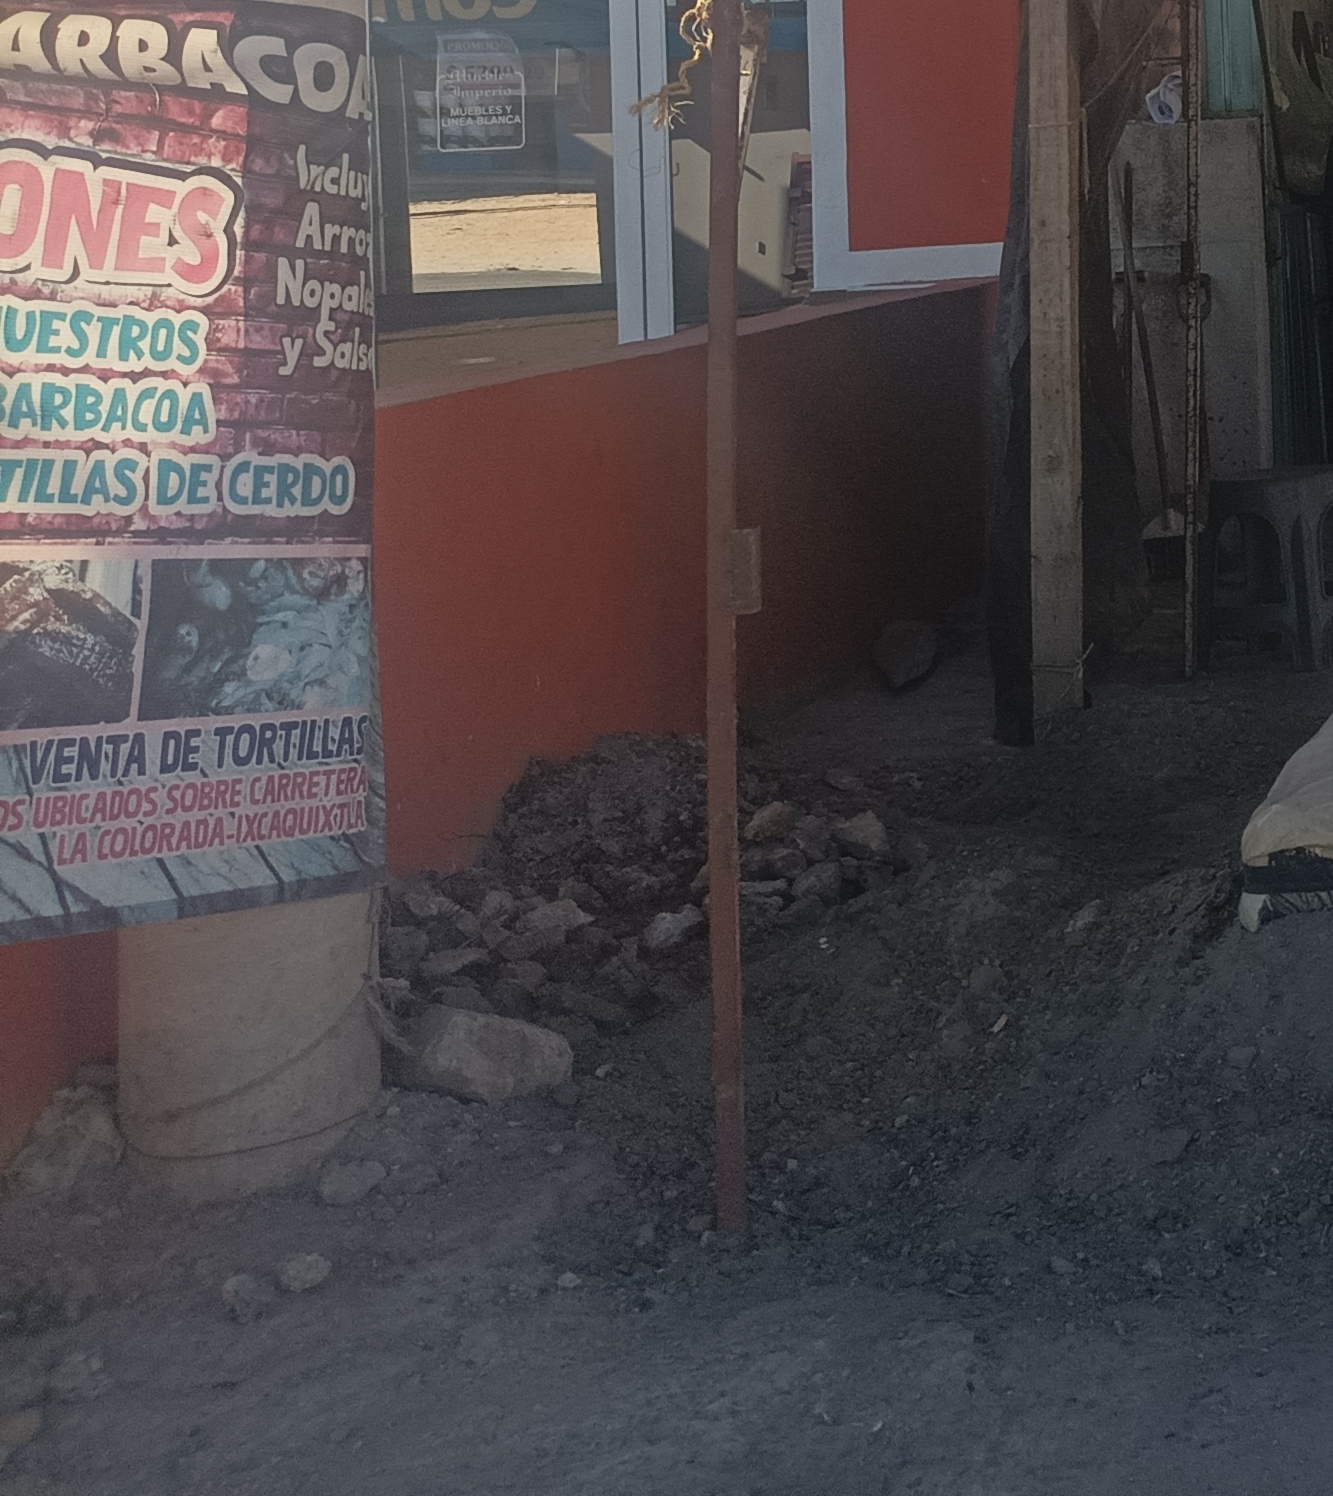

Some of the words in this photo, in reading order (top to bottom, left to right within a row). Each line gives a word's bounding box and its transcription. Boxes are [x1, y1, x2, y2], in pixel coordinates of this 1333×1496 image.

[450, 105, 502, 116] MUEBLES
[505, 104, 512, 114] Y
[476, 114, 522, 125] BLANCA
[0, 304, 200, 365] UESTROS
[278, 337, 304, 376] y
[155, 458, 214, 506] DE
[229, 460, 350, 509] CERDO
[29, 732, 147, 786] VENTA
[160, 728, 202, 775] DE
[213, 713, 370, 770] TORTILLAS
[32, 786, 158, 830] UBICADOS
[165, 778, 243, 816] SOBRE
[250, 765, 367, 806] CARRETERA
[56, 832, 88, 866] LA
